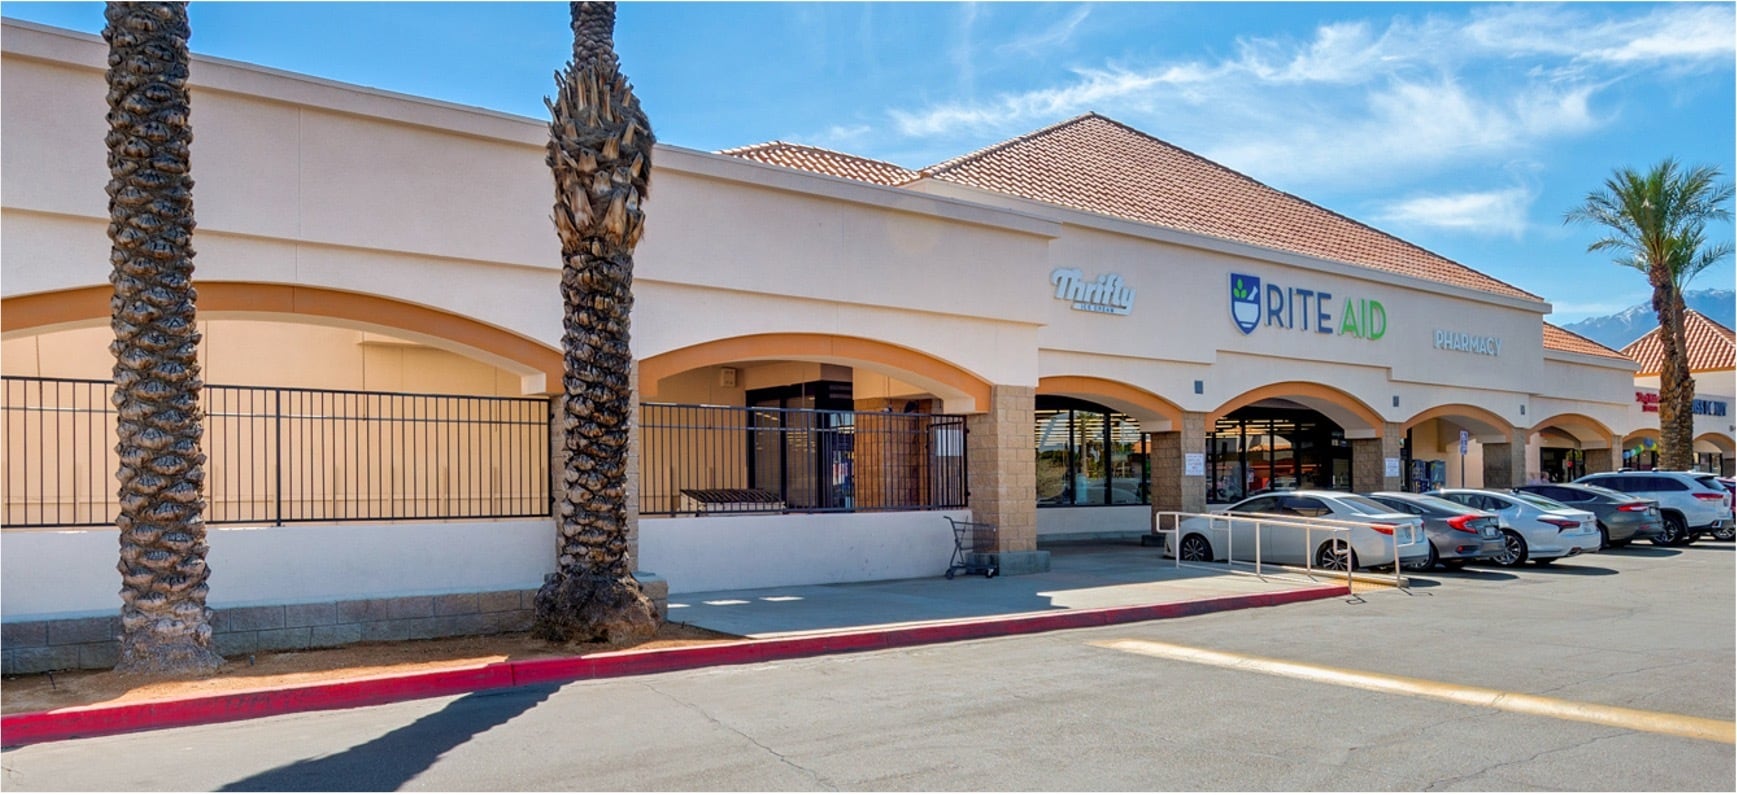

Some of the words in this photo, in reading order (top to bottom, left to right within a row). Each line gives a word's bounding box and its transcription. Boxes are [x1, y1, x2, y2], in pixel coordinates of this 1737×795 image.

[1050, 267, 1136, 315] Thrifty
[1265, 283, 1334, 334] RITE
[1339, 296, 1387, 341] AID
[1434, 329, 1503, 356] PHARMACY
